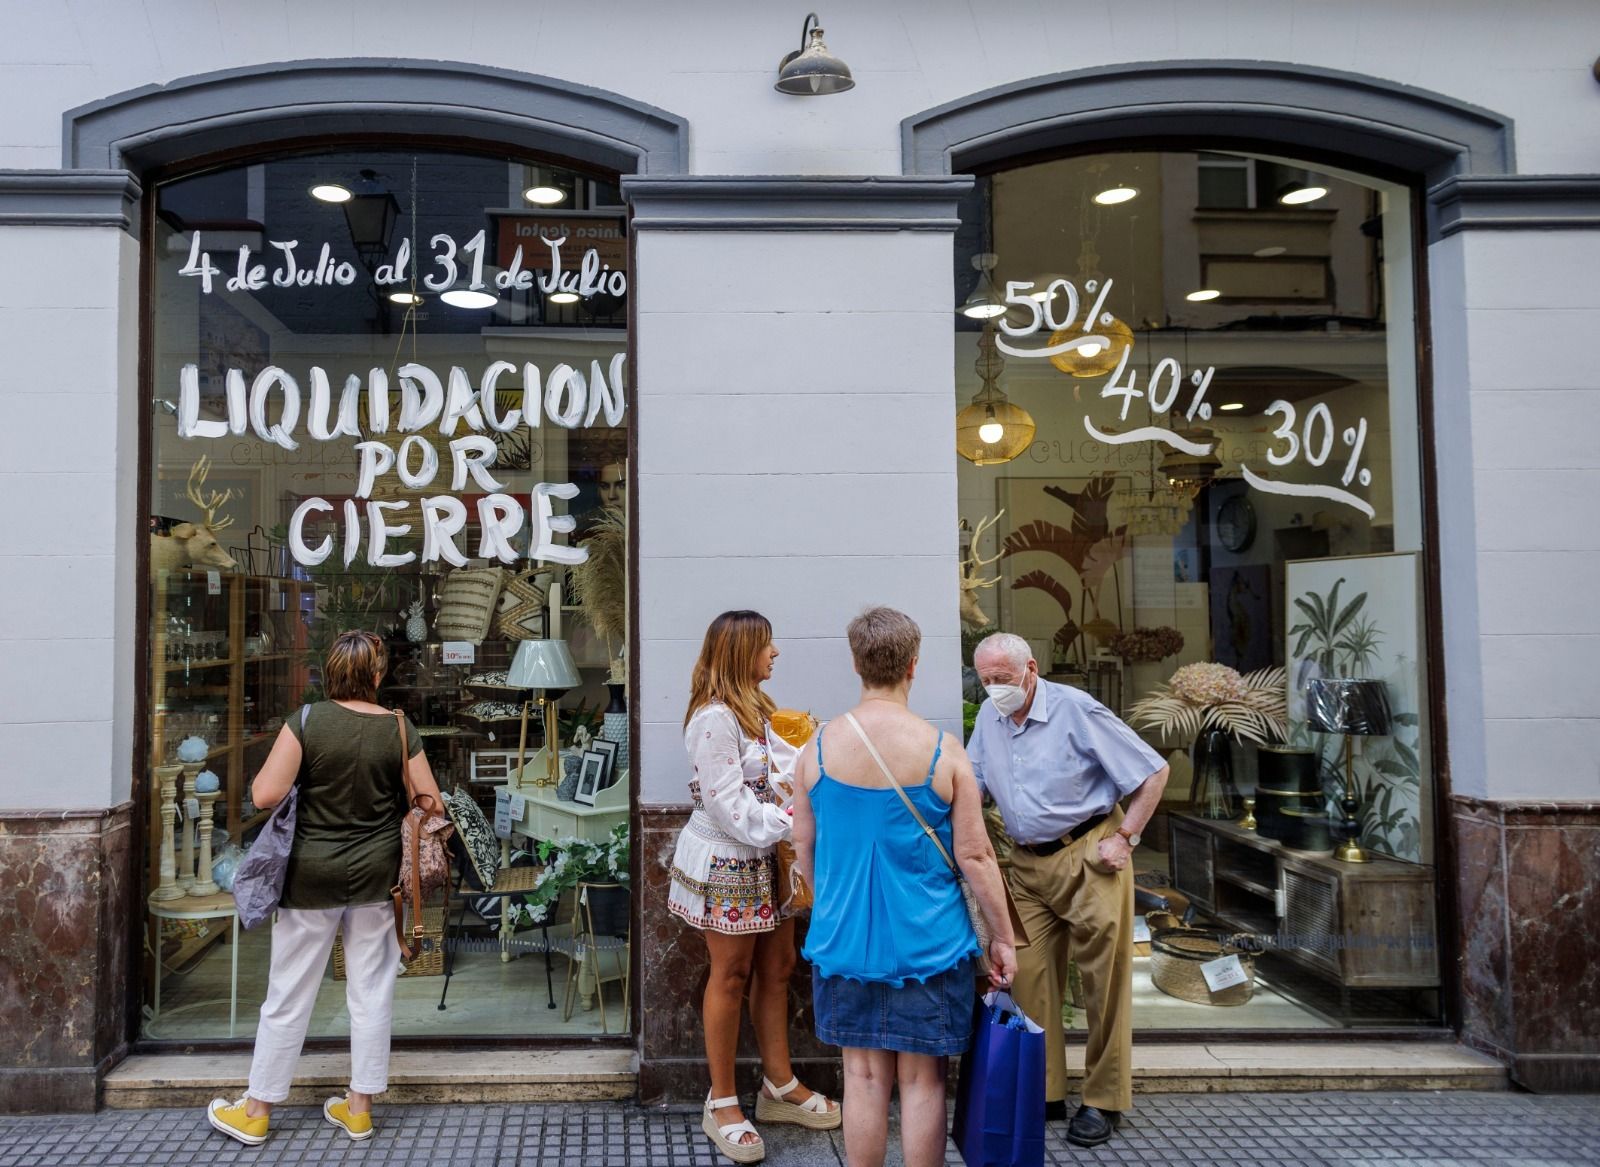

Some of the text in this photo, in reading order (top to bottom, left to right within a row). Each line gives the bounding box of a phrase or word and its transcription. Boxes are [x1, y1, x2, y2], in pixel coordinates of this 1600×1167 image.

[178, 229, 627, 297] 4 de Julio al 31 de Julio
[995, 278, 1115, 337] 50%
[177, 352, 627, 451] LIQUIDACION
[1100, 343, 1215, 422] 40%
[353, 434, 509, 499] POR
[1264, 400, 1373, 488] 30%
[288, 482, 590, 569] CIERRE
